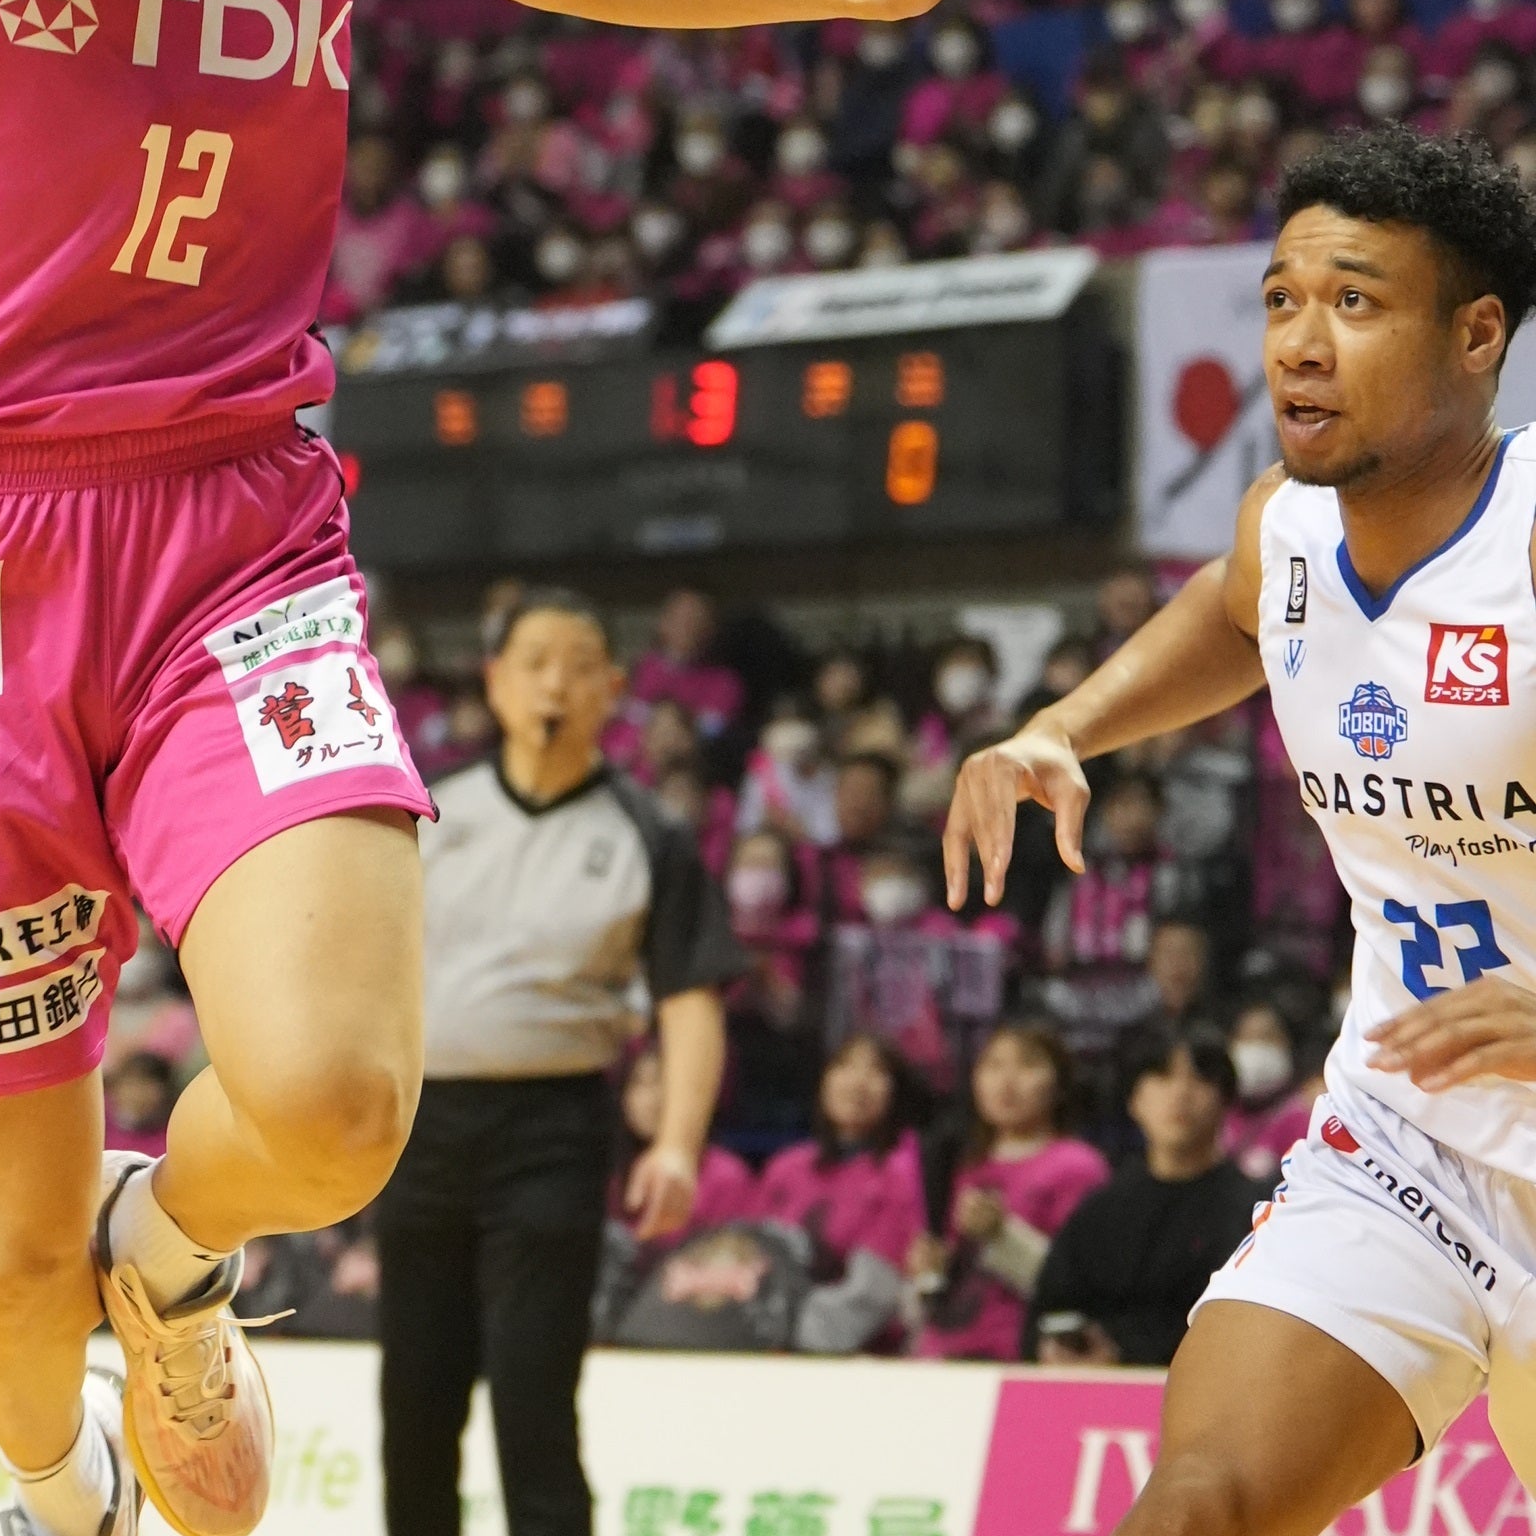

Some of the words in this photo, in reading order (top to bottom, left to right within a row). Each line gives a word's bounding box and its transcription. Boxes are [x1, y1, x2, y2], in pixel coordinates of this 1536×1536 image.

[110, 123, 234, 287] 12
[1431, 627, 1501, 686] K's
[1430, 686, 1502, 704] ケーズデンキ
[1340, 703, 1407, 740] ROBOTS
[1302, 771, 1536, 821] DASTRIA
[1405, 834, 1457, 867] Play
[1457, 834, 1536, 856] fash
[1383, 898, 1512, 1004] 22
